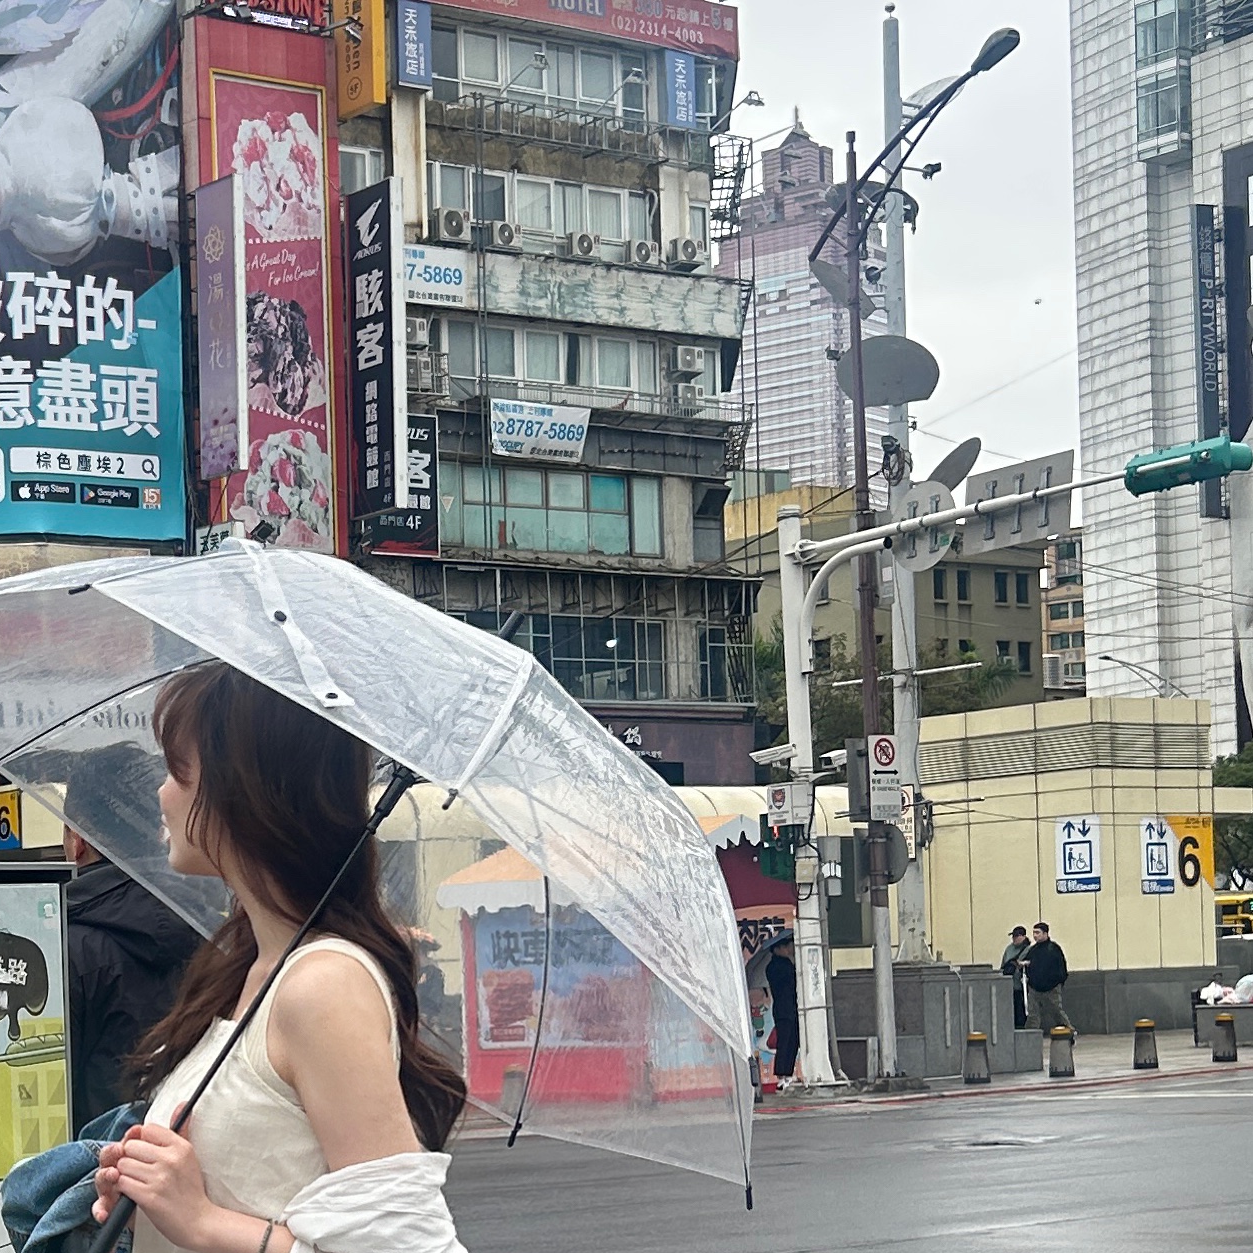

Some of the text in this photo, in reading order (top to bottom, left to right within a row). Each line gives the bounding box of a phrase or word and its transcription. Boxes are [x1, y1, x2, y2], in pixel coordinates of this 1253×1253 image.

[281, 248, 297, 267] Day
[268, 271, 281, 287] For
[404, 263, 462, 285] 7-5869
[1201, 278, 1216, 392] PRTYWORLD
[506, 418, 584, 441] 8787-5869
[36, 451, 125, 475] 棕色塵埃2
[34, 483, 69, 494] App Store
[97, 488, 131, 499] Google Play
[406, 515, 422, 530] 4F
[1178, 835, 1201, 887] 6
